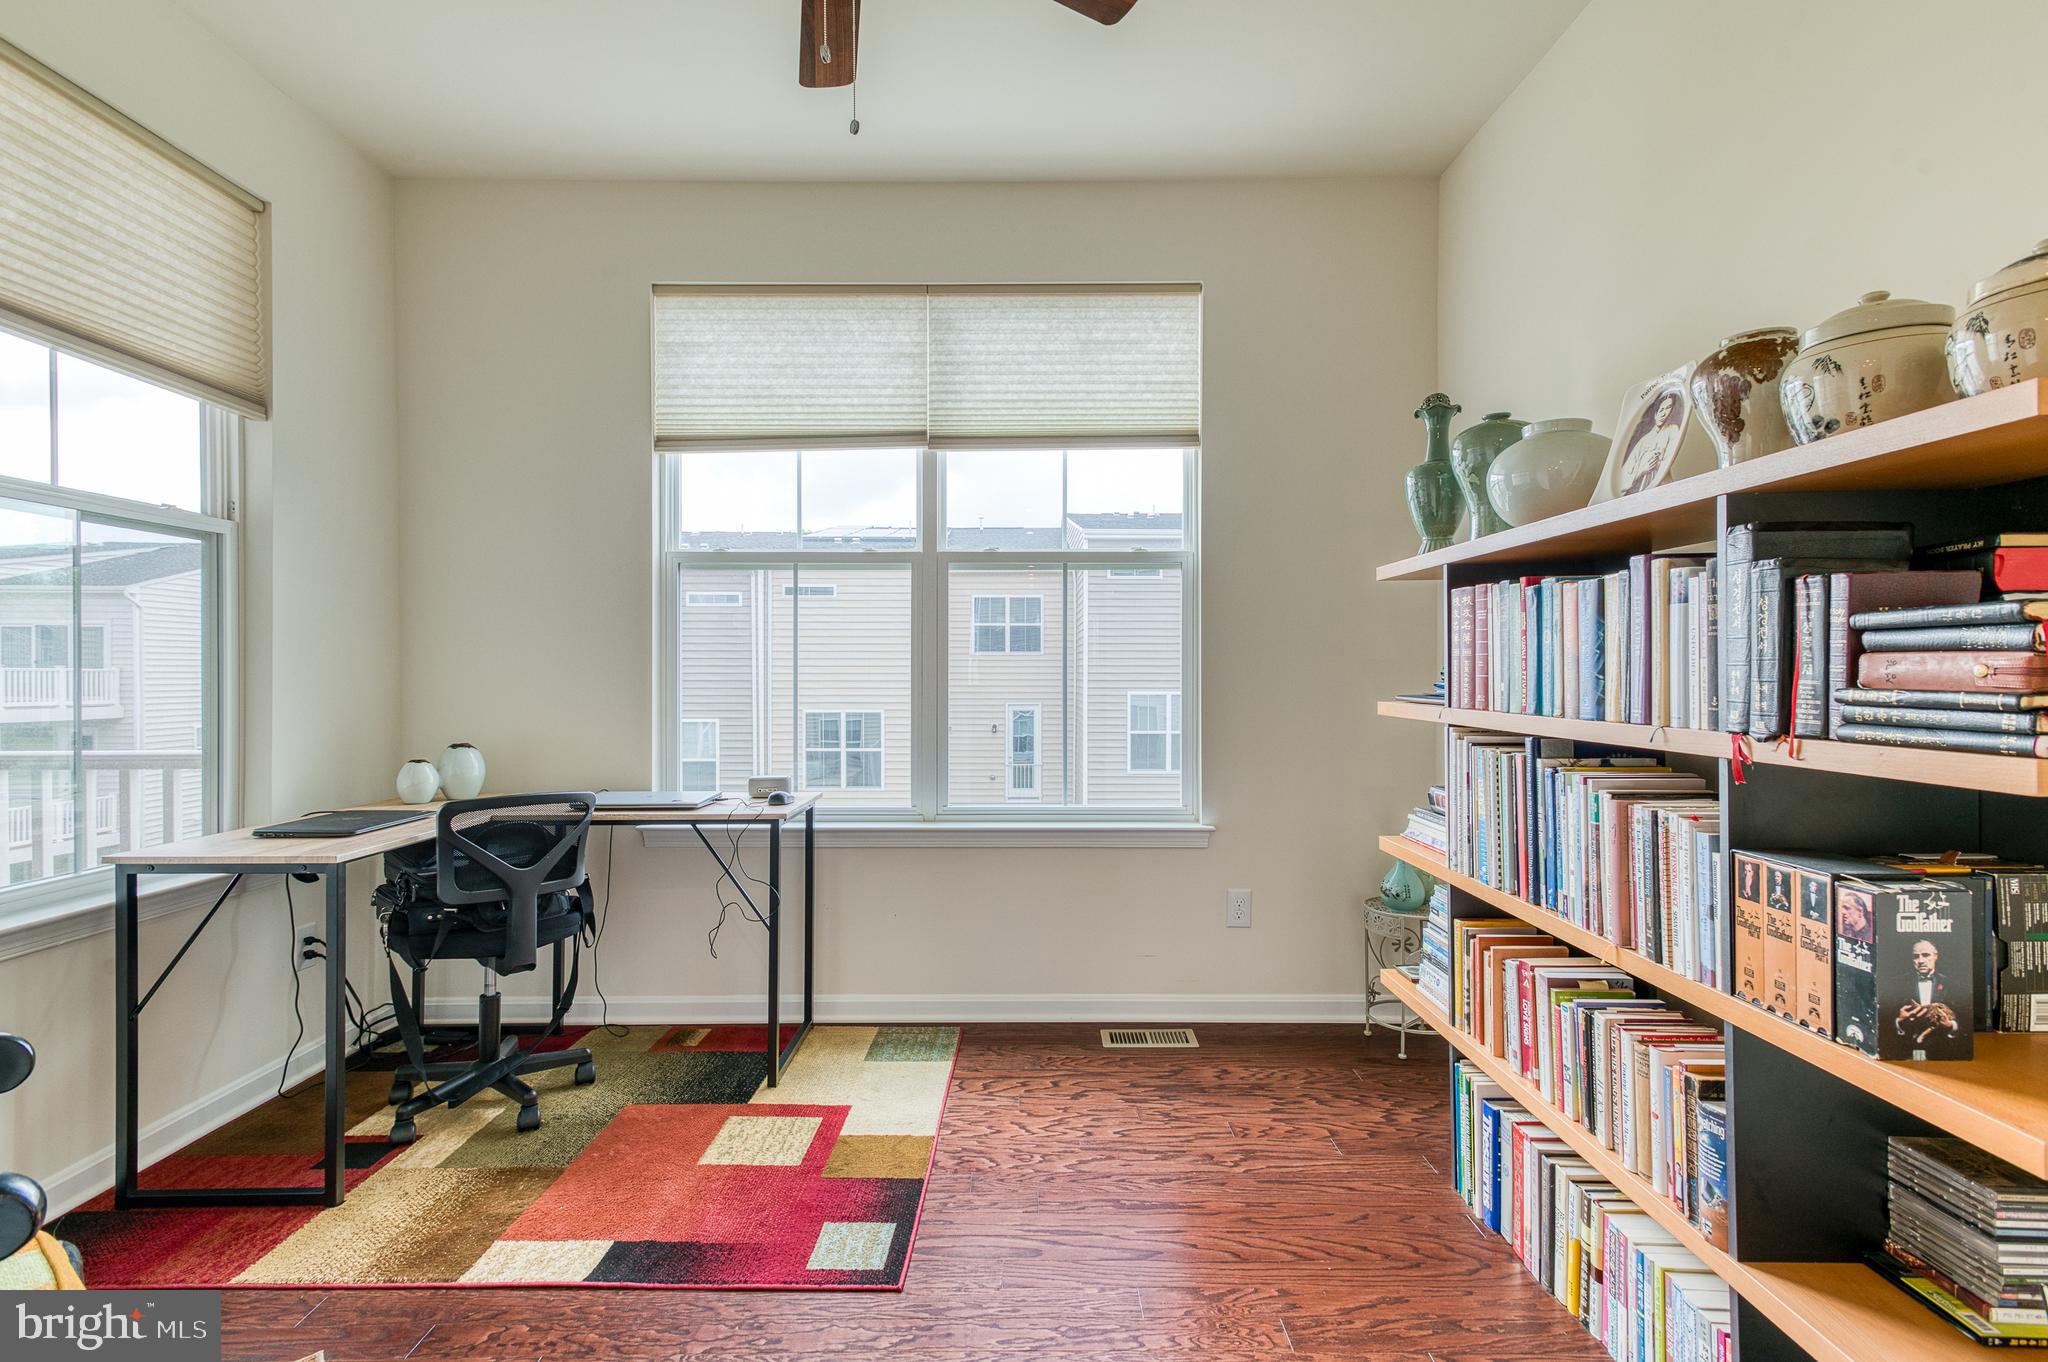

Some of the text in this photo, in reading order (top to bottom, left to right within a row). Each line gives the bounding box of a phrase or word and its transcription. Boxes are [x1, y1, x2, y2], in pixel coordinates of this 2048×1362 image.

[2010, 877, 2020, 895] VHS
[1737, 905, 1745, 918] The
[1896, 894, 1920, 912] The
[1737, 916, 1761, 932] Godfather
[1767, 912, 1776, 925] The
[1896, 911, 1953, 933] Godfather
[1767, 923, 1793, 944] Godfather
[1800, 923, 1811, 937] The
[1800, 935, 1829, 957] Godfather
[1837, 936, 1852, 952] The
[1837, 949, 1873, 973] Godfather
[1522, 998, 1532, 1047] LOVE SIGNS
[1482, 1113, 1492, 1209] Thesaurus
